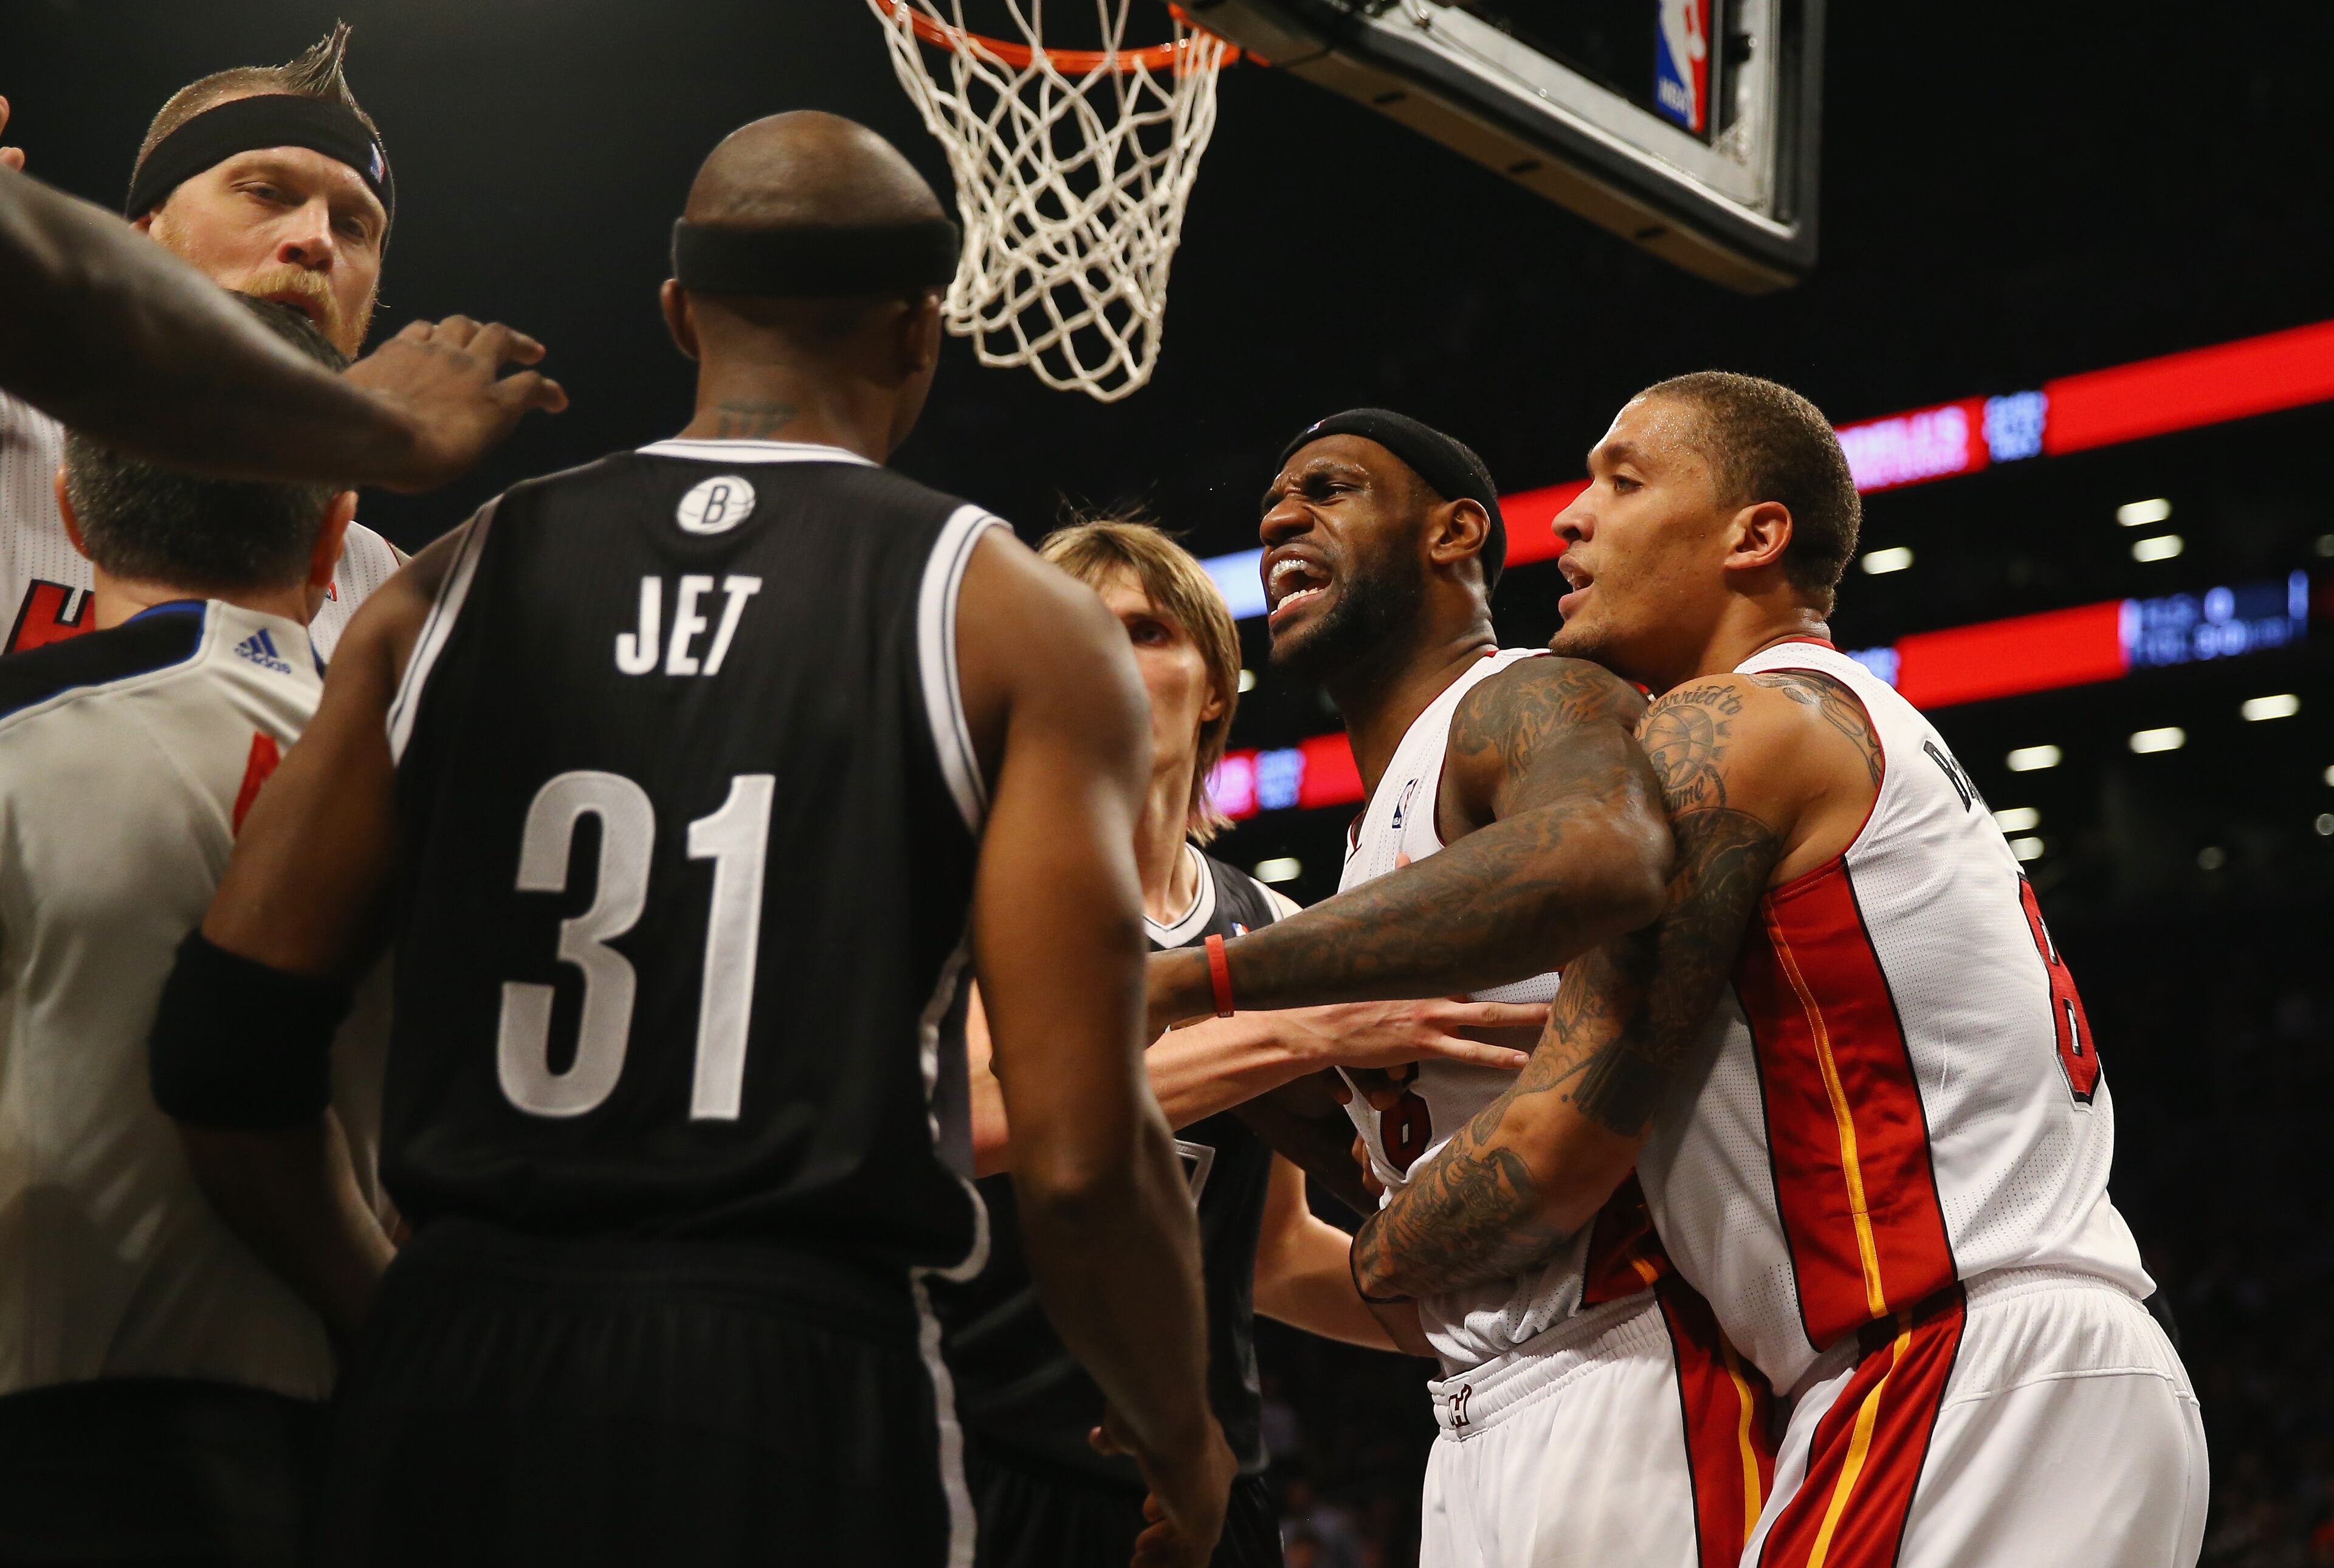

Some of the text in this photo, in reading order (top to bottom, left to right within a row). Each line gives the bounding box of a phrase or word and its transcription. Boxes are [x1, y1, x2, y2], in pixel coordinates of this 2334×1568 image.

[701, 484, 729, 524] B
[615, 575, 763, 676] JET
[497, 769, 776, 1121] 31
